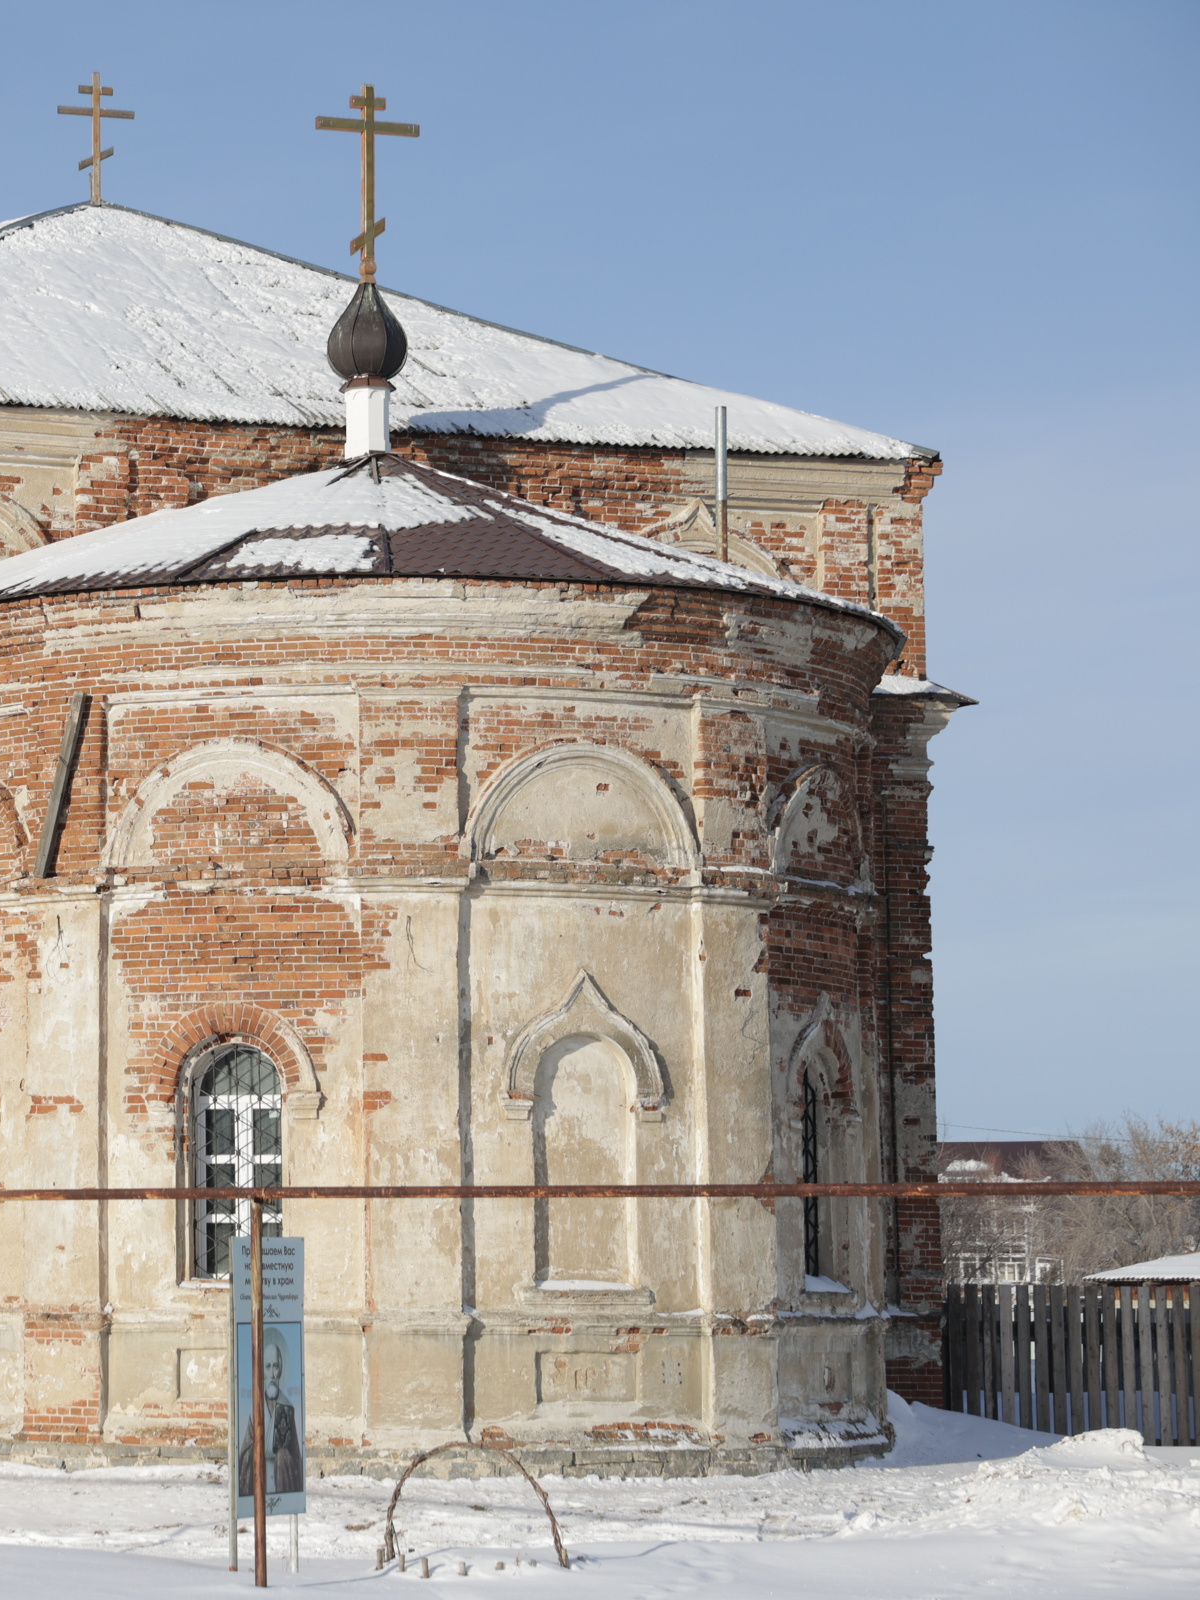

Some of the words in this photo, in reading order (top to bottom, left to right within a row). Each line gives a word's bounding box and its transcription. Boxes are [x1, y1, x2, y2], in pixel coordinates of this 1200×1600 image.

[284, 1246, 296, 1256] Вас
[256, 1262, 294, 1272] вместную
[245, 1278, 271, 1287] мтву
[278, 1278, 294, 1287] храм
